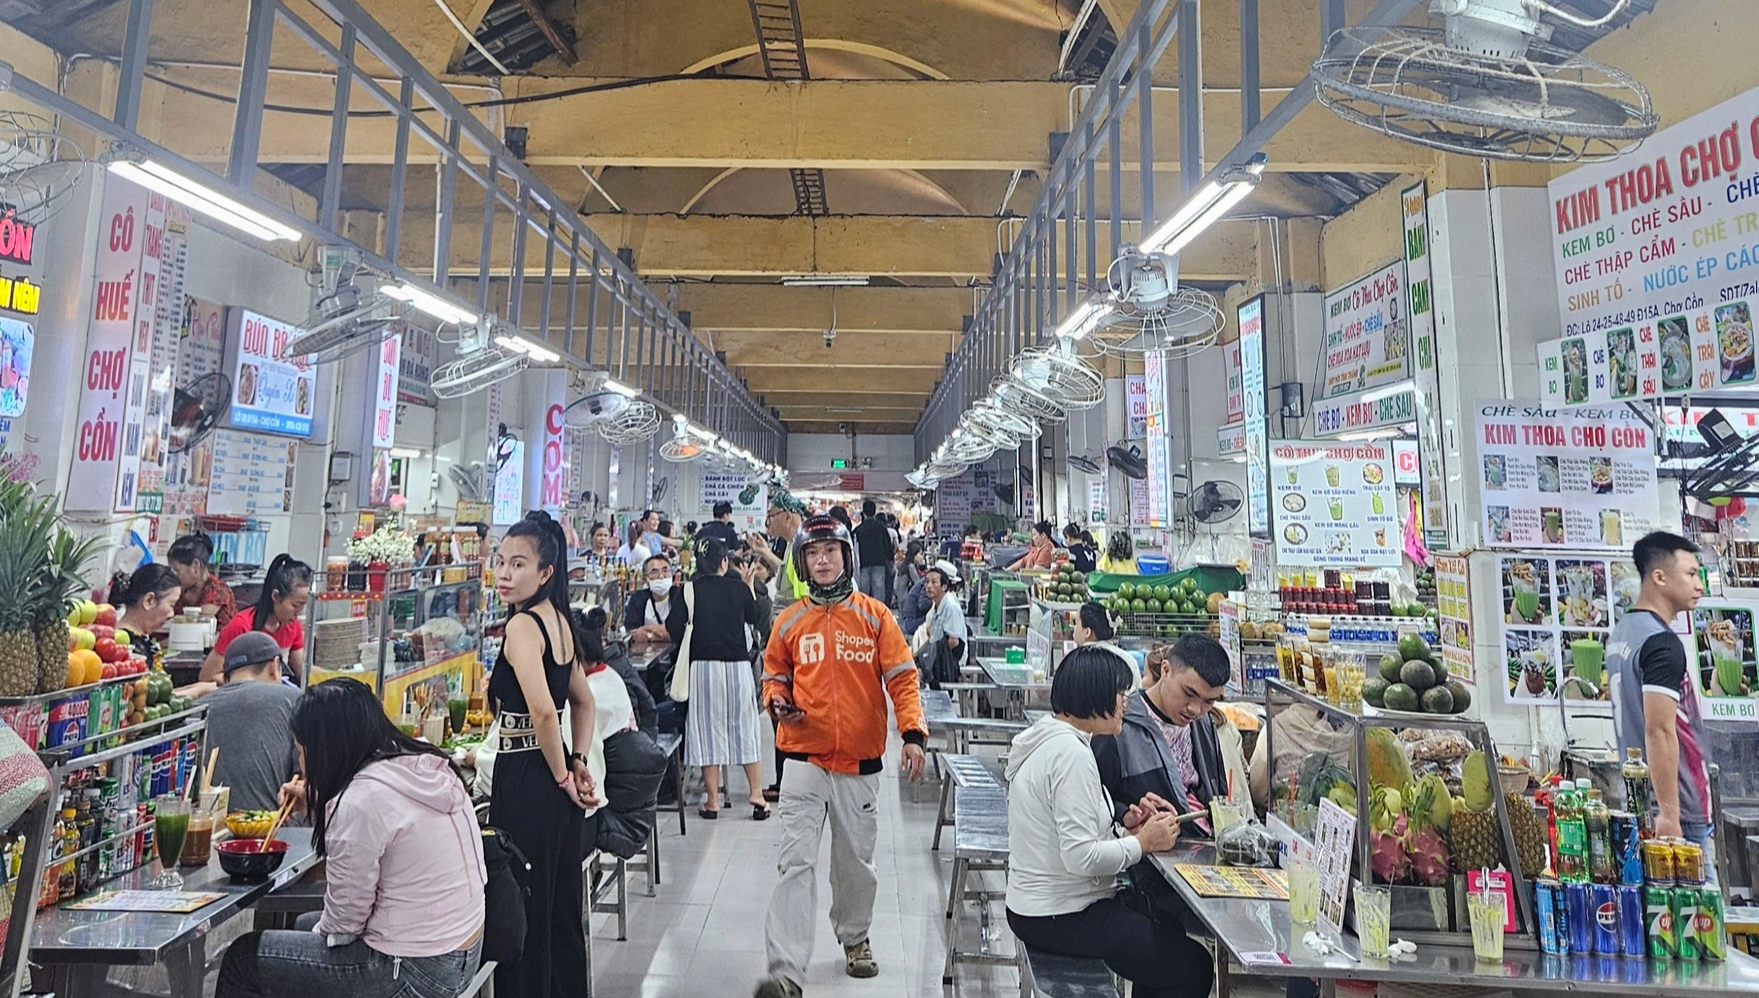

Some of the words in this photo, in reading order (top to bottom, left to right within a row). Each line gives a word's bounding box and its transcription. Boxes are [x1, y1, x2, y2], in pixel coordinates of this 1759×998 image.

[1556, 183, 1600, 235] KIM
[1605, 156, 1674, 216] THOA
[1680, 120, 1742, 187] CHỢ
[110, 206, 134, 253] CÔ
[1562, 235, 1591, 259] KEM
[1596, 225, 1616, 248] BƠ
[1631, 208, 1662, 235] CHÈ
[1668, 196, 1703, 223] SẦU
[1565, 262, 1592, 285] CHÈ
[1596, 251, 1633, 275] THẬP
[1640, 234, 1675, 263] CẨM
[1692, 218, 1728, 248] CHÈ
[95, 269, 135, 321] HUẾ
[1568, 290, 1600, 312] SINH
[1605, 278, 1624, 300] TỐ
[1644, 265, 1689, 292] NƯỚC
[1696, 257, 1718, 280] ÉP
[87, 347, 126, 399] CHỢ
[78, 408, 119, 462] CỒN
[1484, 423, 1517, 445] KIM
[1521, 425, 1567, 447] THOA
[1571, 424, 1606, 451] CHỢ
[1611, 421, 1646, 448] CỒN
[1574, 408, 1613, 420] KEM
[835, 643, 876, 664] Food
[1712, 703, 1736, 716] KEM
